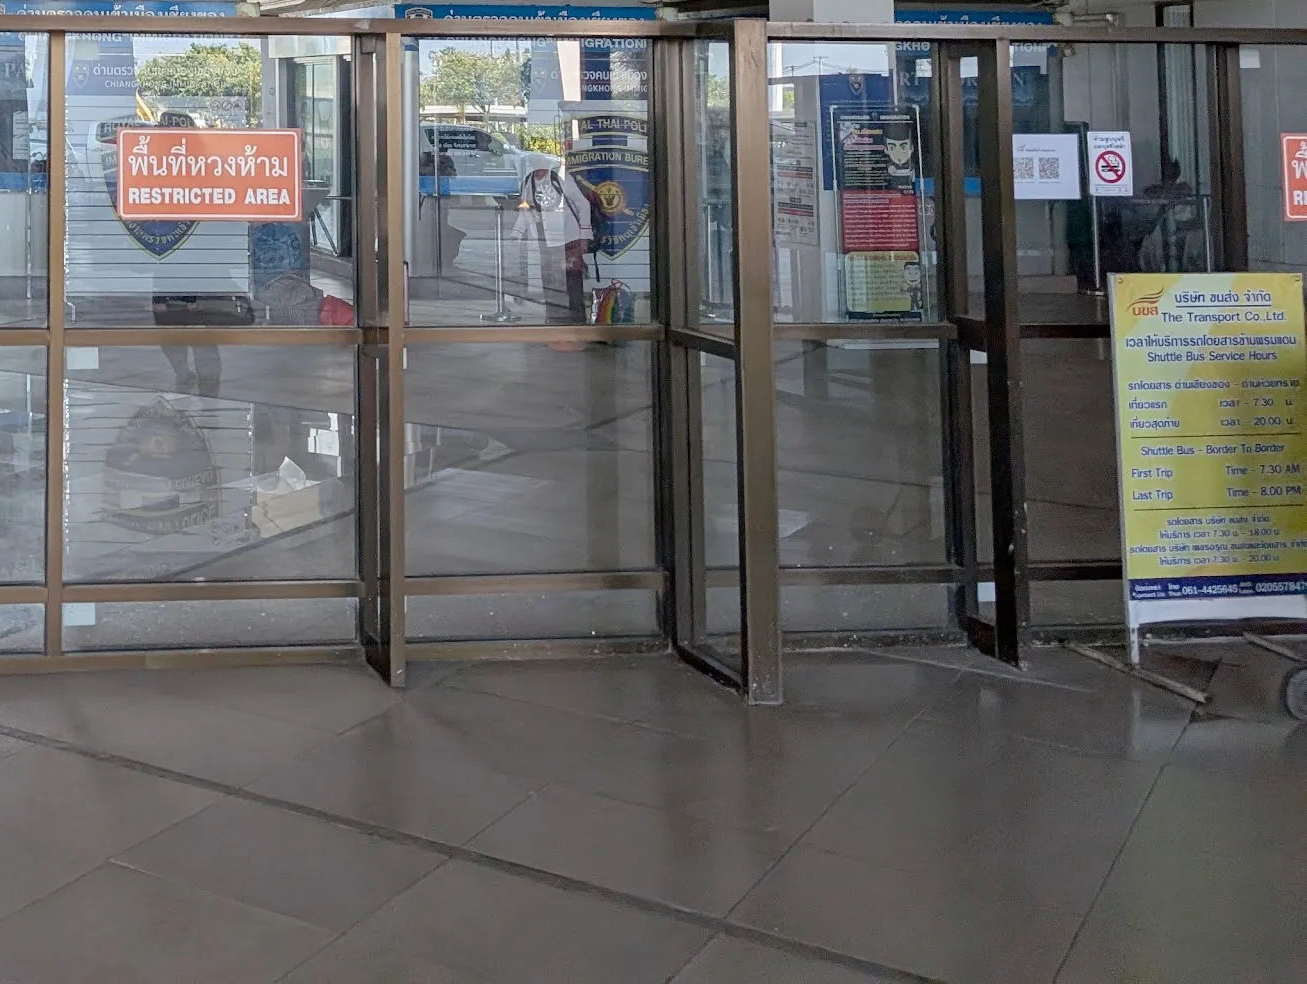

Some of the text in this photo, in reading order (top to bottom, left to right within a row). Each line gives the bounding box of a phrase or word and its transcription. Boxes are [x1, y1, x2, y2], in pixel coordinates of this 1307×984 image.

[597, 118, 621, 129] THAI
[624, 119, 648, 133] POLI
[128, 135, 288, 177] พื้นที่หวงห้าม
[625, 152, 649, 166] BURE
[128, 187, 290, 205] RESTRICTED AREA
[1174, 289, 1271, 303] บริษัท ขนส่ง จำกัด
[1132, 302, 1159, 316] บขส
[1161, 311, 1287, 323] The Transport Co.,Ltd.
[1147, 350, 1277, 362] Shuttle Bus Service Hours
[1219, 398, 1240, 408] เวลา
[1221, 418, 1240, 427] เวลา
[1141, 443, 1284, 456] Shuttle Bus Border To Border
[1131, 468, 1152, 478] First
[1156, 467, 1173, 479] Trip
[1225, 465, 1248, 475] Time
[1285, 464, 1301, 473] AM
[1132, 486, 1301, 501] Last Trip Time 8.00 PM
